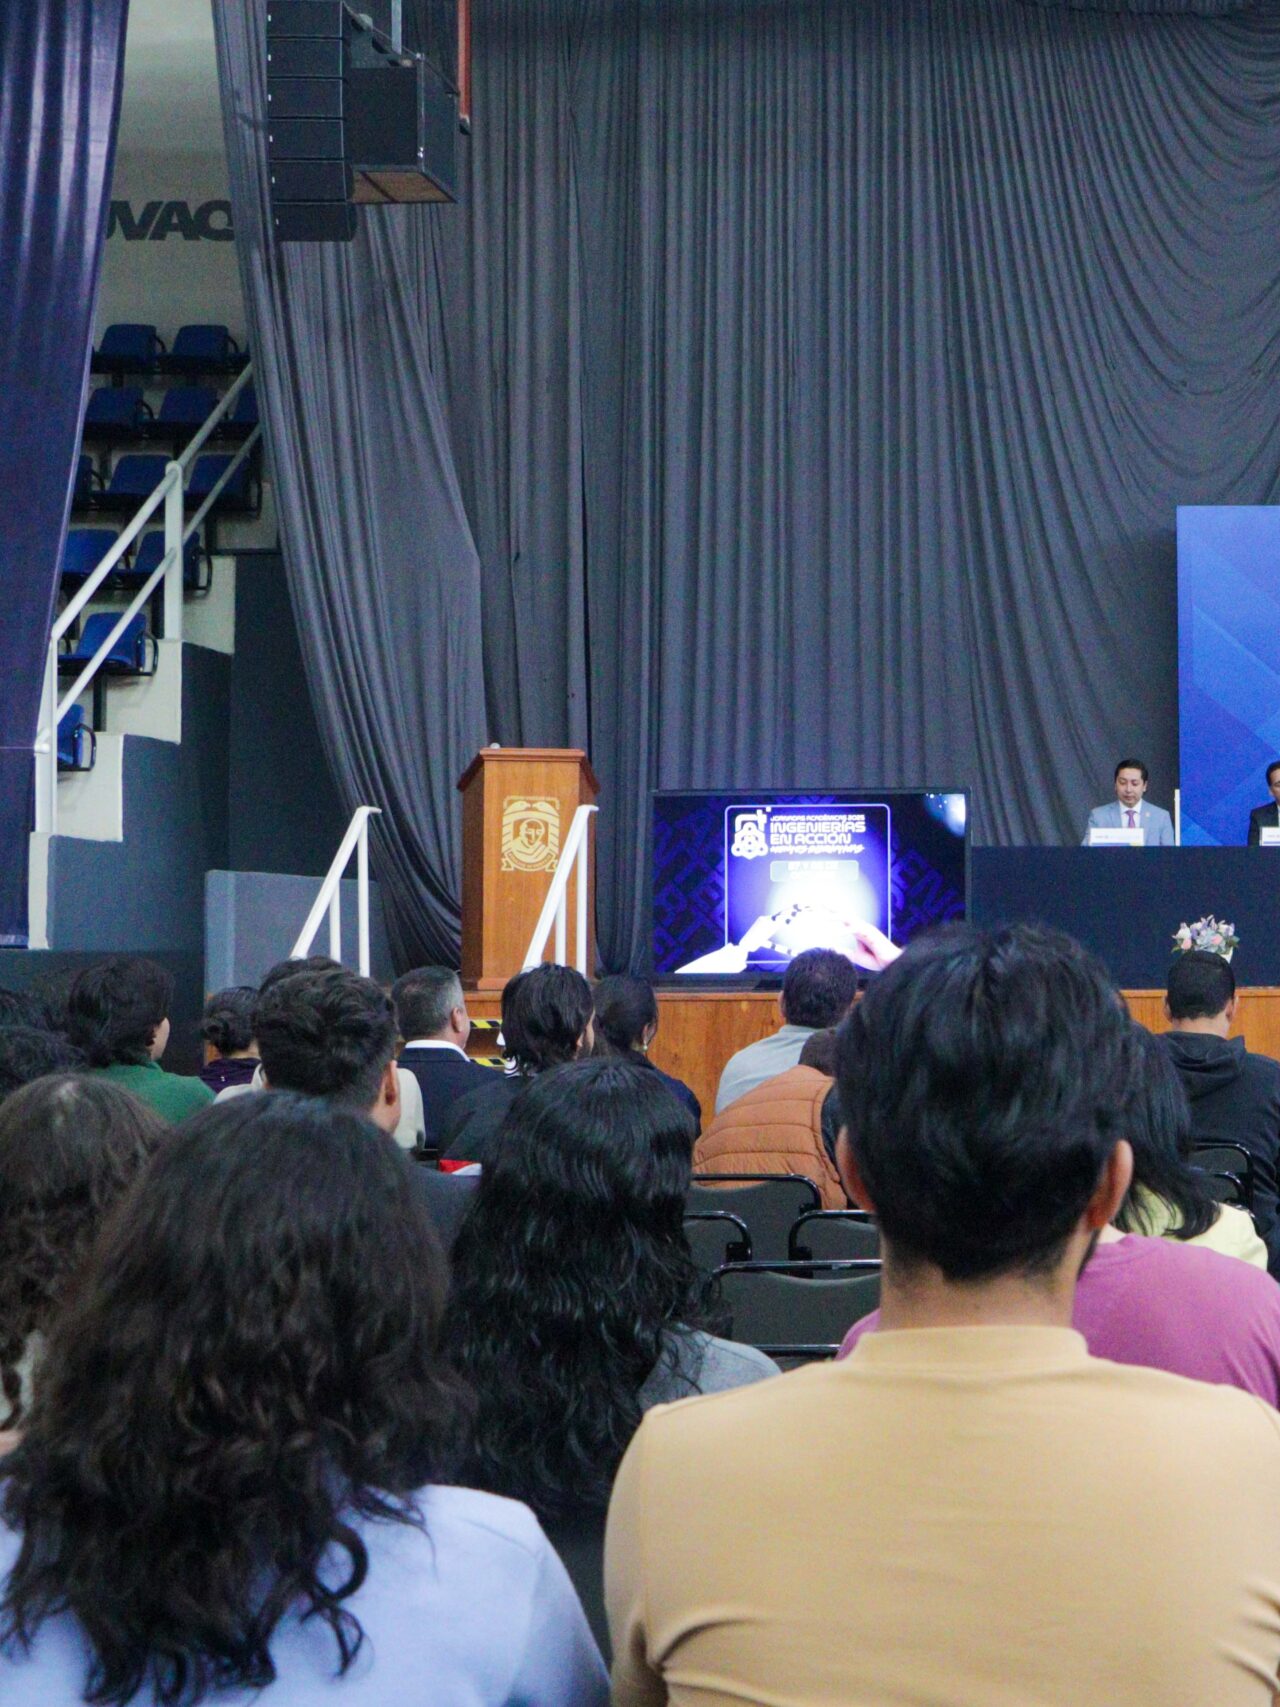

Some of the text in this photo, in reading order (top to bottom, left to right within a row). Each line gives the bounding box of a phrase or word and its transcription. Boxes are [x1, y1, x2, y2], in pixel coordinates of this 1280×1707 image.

[106, 200, 235, 241] VAQ
[770, 820, 866, 833] INGENIERÍAS
[770, 831, 851, 845] EN ACCIÓN
